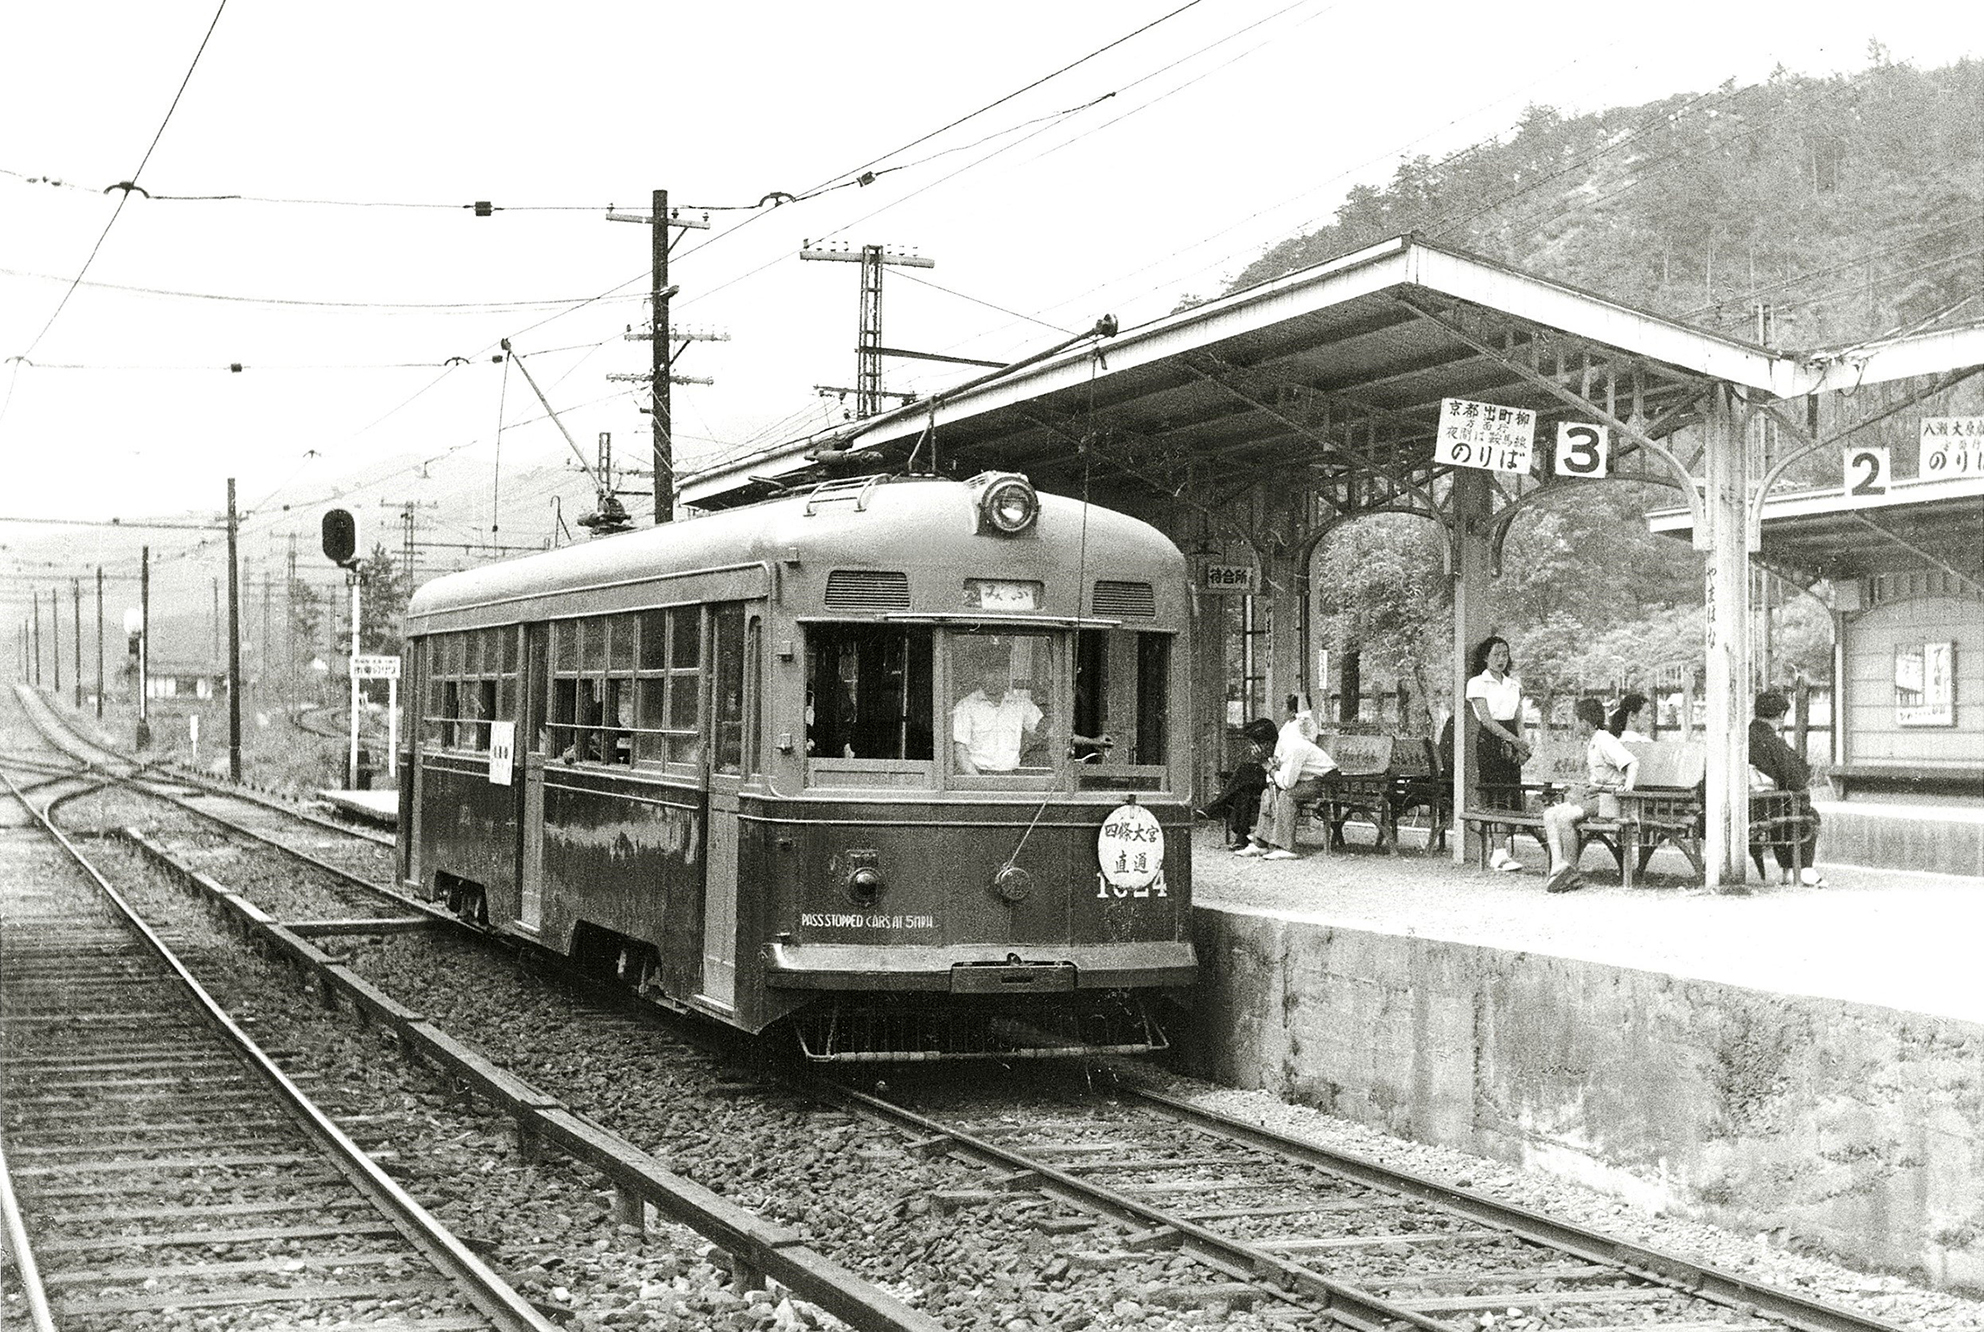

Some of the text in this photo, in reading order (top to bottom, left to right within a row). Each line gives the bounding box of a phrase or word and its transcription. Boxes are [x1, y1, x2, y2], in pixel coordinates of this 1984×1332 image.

[1449, 400, 1530, 426] 京都出町柳
[1451, 441, 1525, 470] のりば
[1563, 426, 1601, 473] 3
[1851, 452, 1886, 496] 2
[1209, 567, 1248, 584] 待合所
[1113, 849, 1149, 874] 直通
[801, 912, 824, 927] PASS
[824, 913, 864, 928] STOPPED
[865, 914, 891, 929] CARS
[892, 915, 904, 929] AT
